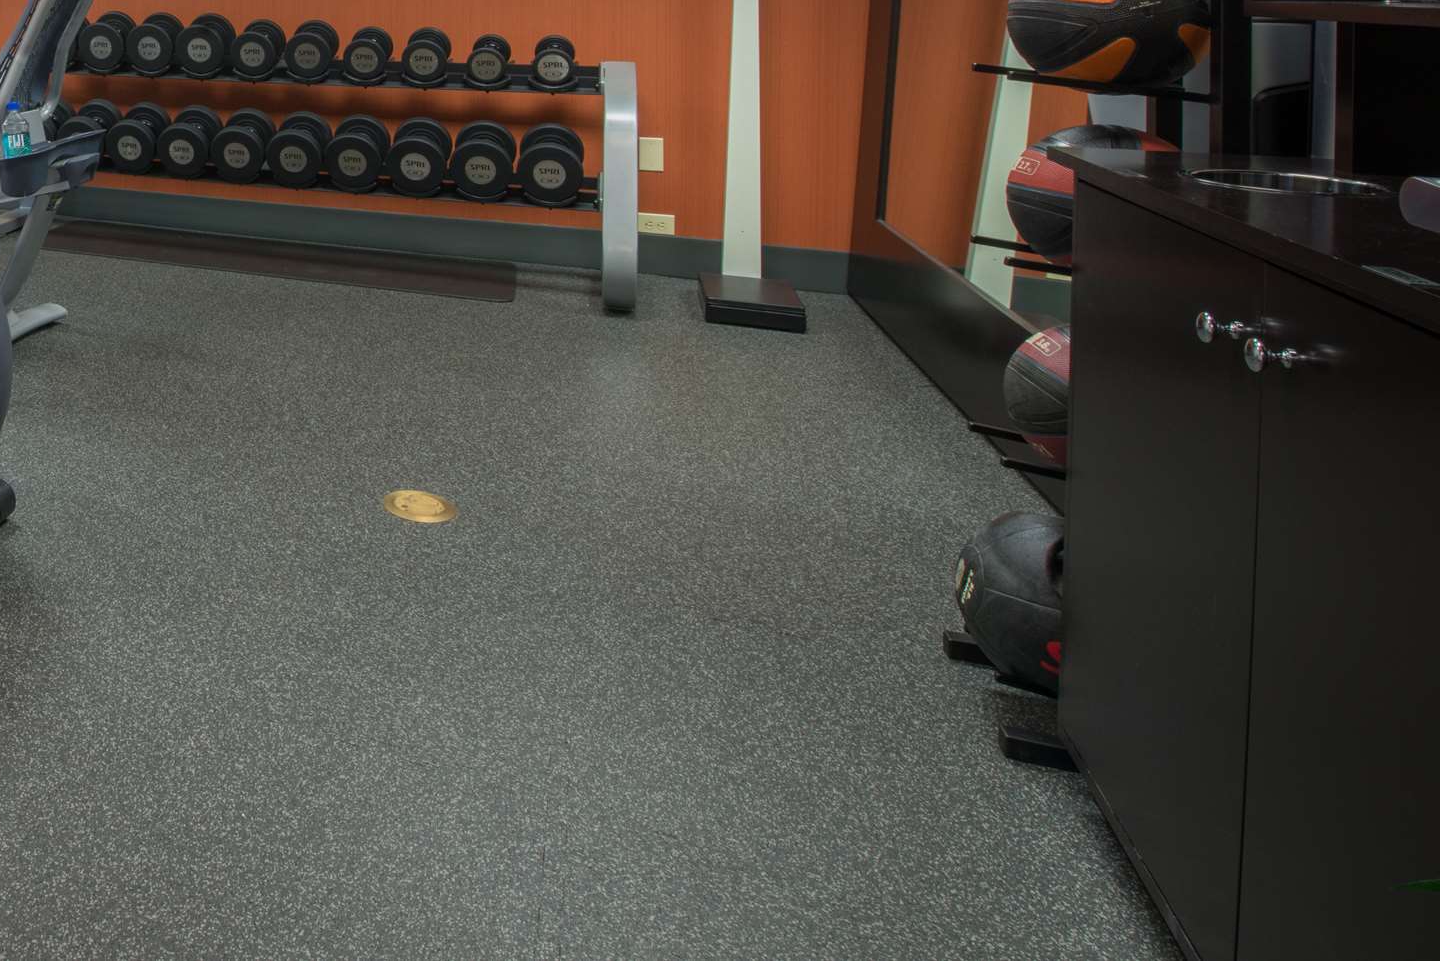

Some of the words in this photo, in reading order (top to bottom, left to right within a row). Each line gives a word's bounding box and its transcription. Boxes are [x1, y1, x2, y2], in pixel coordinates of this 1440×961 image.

[476, 59, 496, 67] SPRI
[542, 61, 563, 69] SPRI
[405, 159, 425, 168] SPRI
[470, 163, 490, 171] SPRI
[538, 167, 560, 175] SPRI
